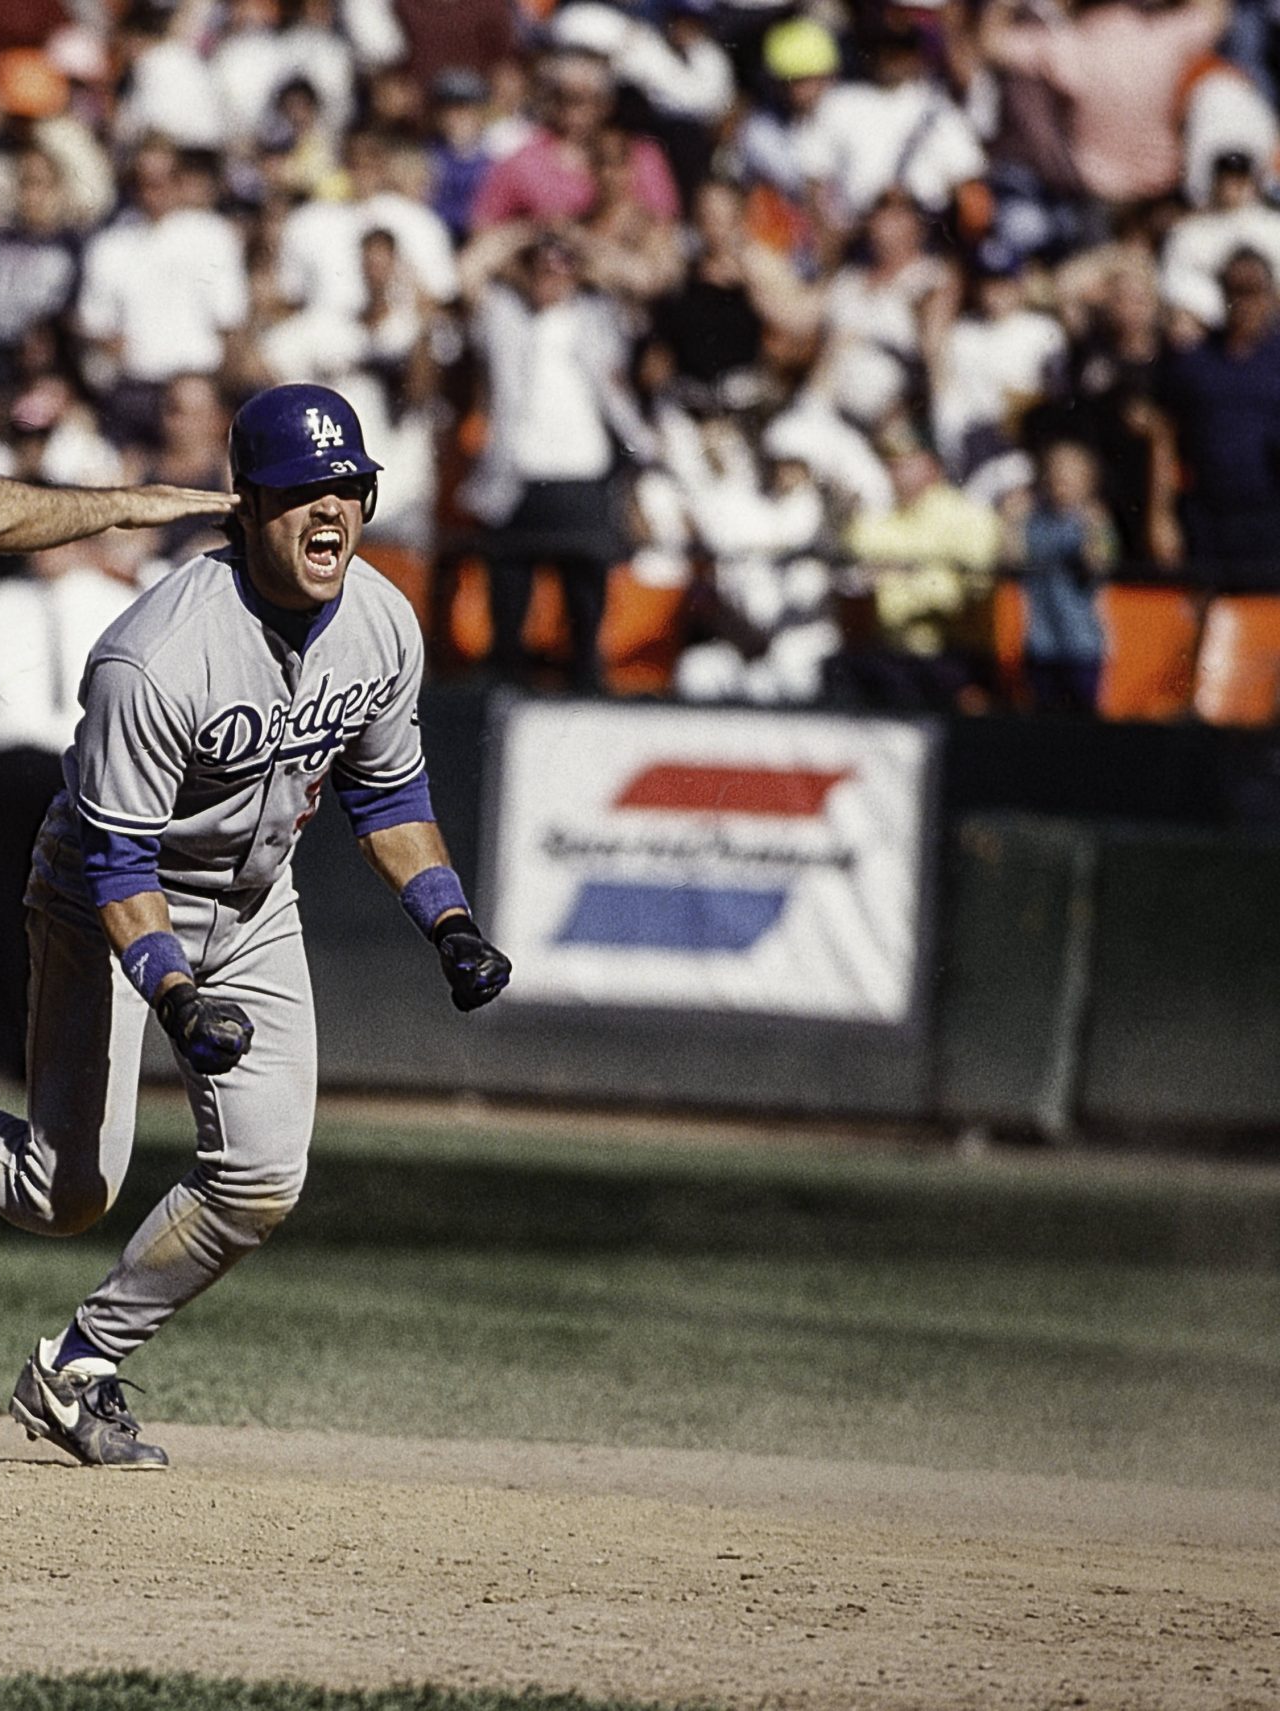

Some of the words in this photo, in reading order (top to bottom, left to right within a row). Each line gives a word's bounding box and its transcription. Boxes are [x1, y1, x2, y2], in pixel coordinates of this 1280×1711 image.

[305, 407, 344, 448] LA
[329, 459, 358, 474] 31
[195, 666, 400, 775] Dodgers
